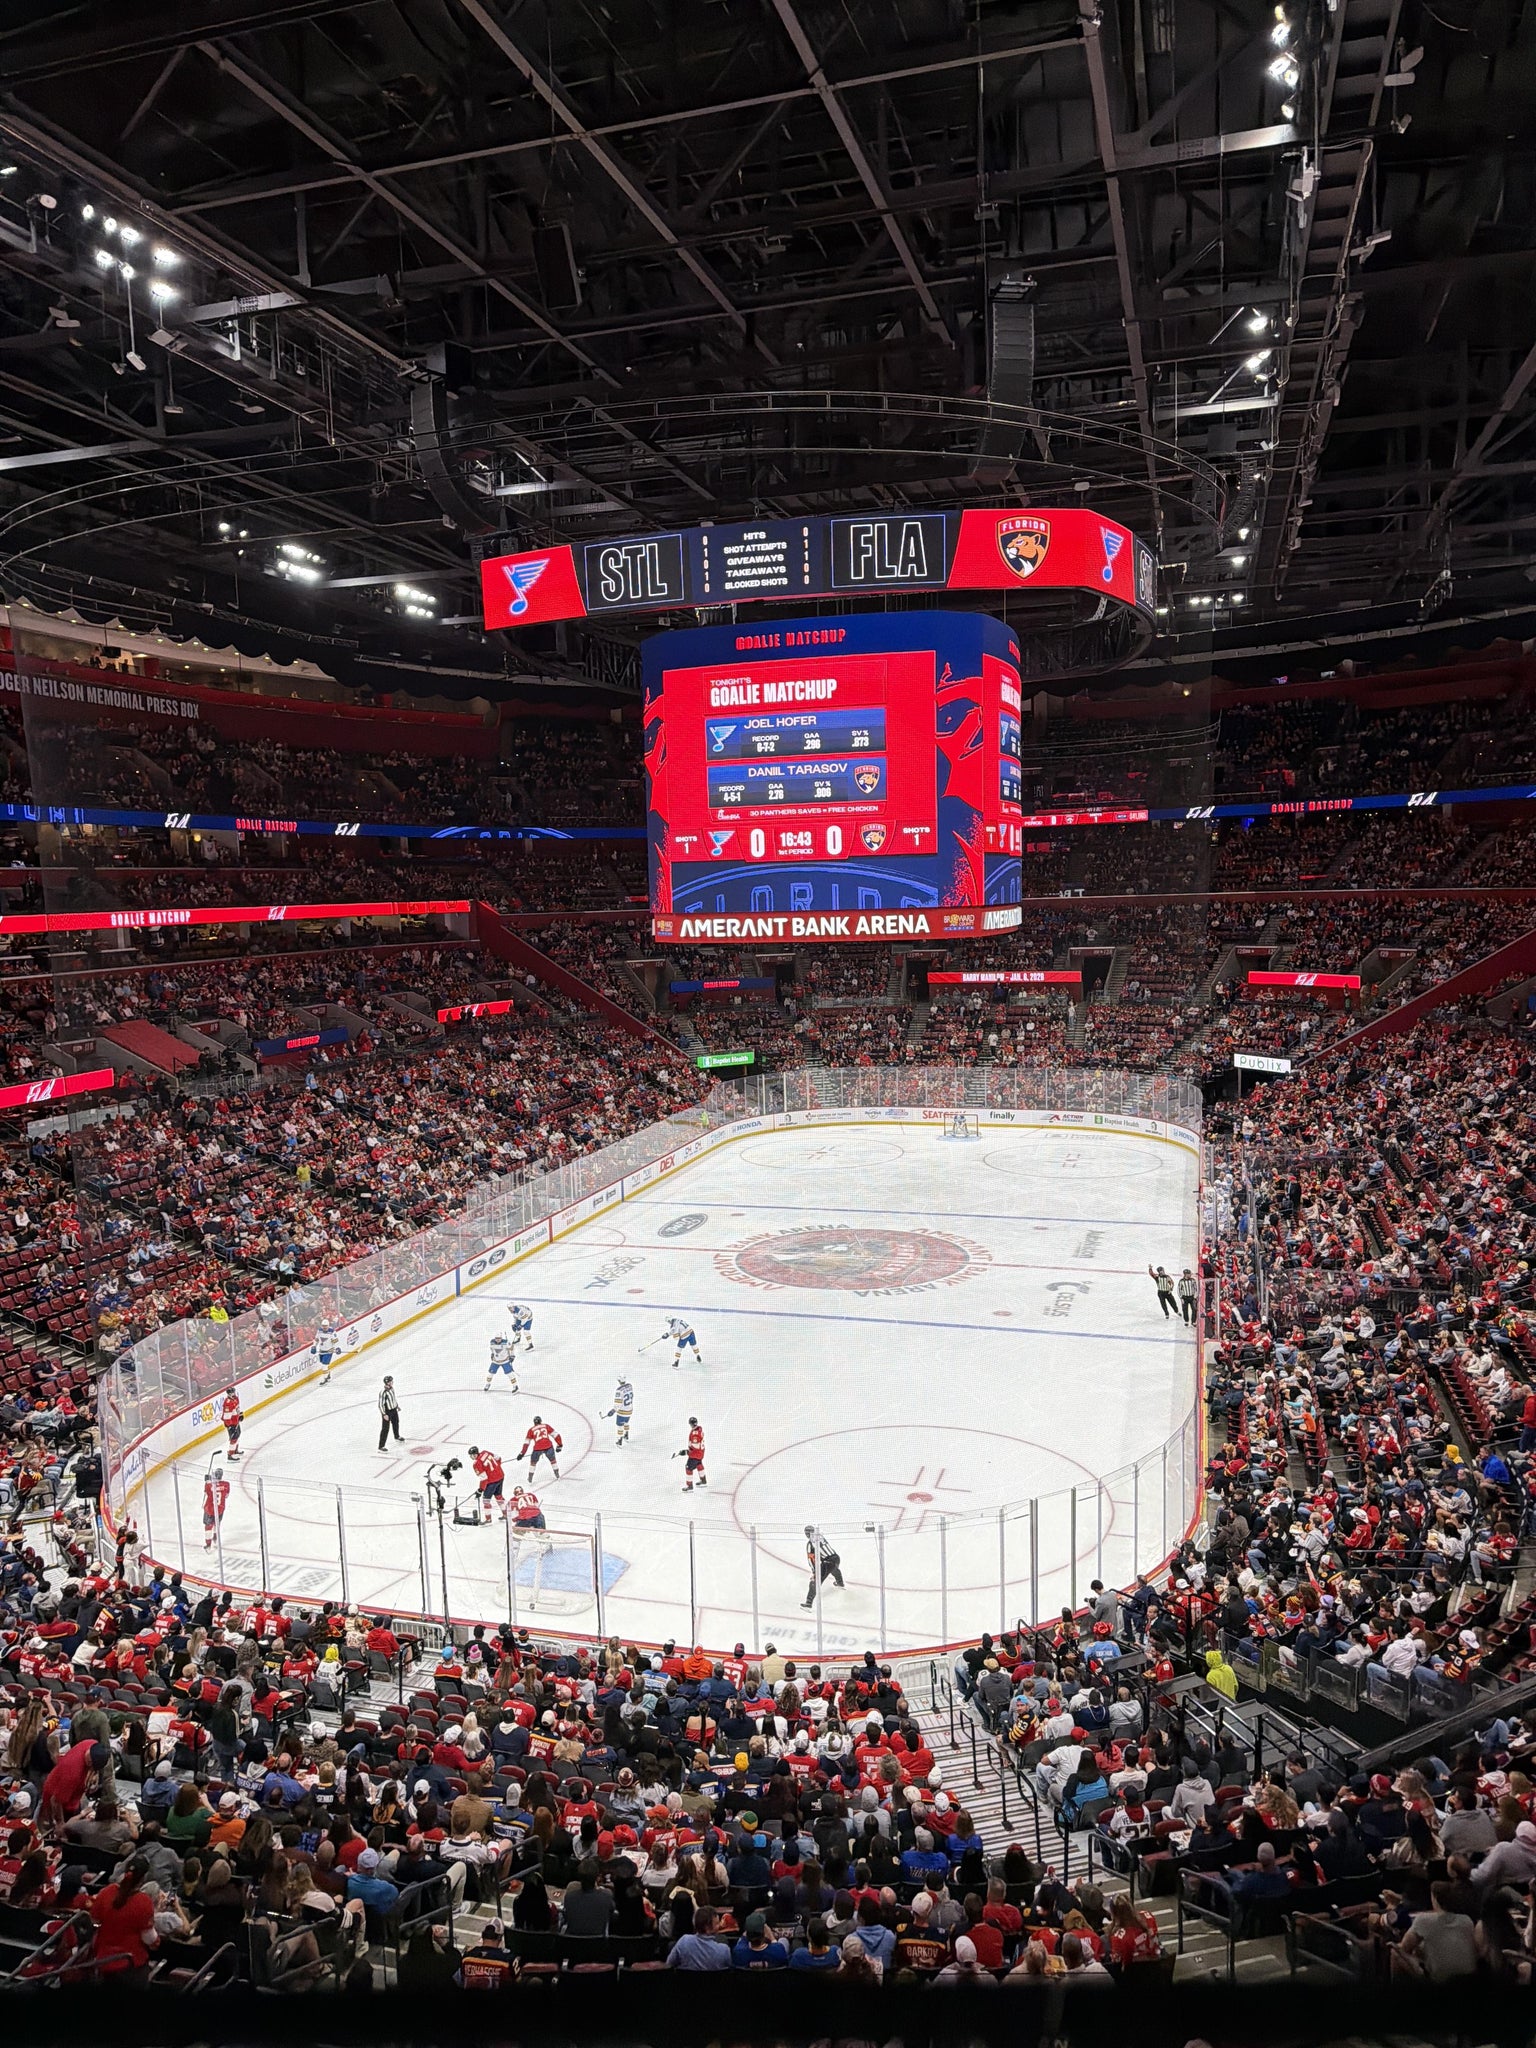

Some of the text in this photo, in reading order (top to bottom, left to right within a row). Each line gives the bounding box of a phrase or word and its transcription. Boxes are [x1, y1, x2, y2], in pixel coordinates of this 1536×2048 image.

[1002, 520, 1045, 532] FLORIDA
[744, 531, 766, 540] HITS
[724, 545, 744, 554] SHOT
[746, 542, 787, 553] ATTEMPTS
[851, 522, 927, 579] FLA
[727, 554, 785, 566] GIVEAWAYS
[600, 543, 667, 602] STL
[726, 565, 786, 578] TAKEAWAYS
[725, 579, 760, 590] BLOCKED
[761, 577, 788, 587] SHOTS
[736, 629, 846, 651] GOALIE MATCHUP
[710, 677, 751, 687] TONIGHT'S
[33, 677, 84, 702] NEILSON
[86, 685, 145, 712] MEMORIAL
[147, 696, 178, 716] PRESS
[180, 702, 200, 719] BOX
[710, 679, 837, 707] GOALIE MATCHUP
[744, 716, 817, 729] JOEL HOFER
[748, 763, 848, 777] DANIIL TARASOV
[1271, 799, 1353, 813] GOALIE MATCHUP
[760, 809, 797, 817] PANTHERS
[235, 817, 263, 830] GOALIE
[750, 828, 766, 858] 0
[780, 831, 812, 847] 16:43
[826, 825, 842, 855] 0
[903, 826, 930, 834] SHOTS
[111, 910, 191, 926] GOALIE MATCHUP
[680, 918, 788, 938] AMERANT
[791, 916, 850, 936] BANK
[855, 914, 930, 935] ARENA
[963, 972, 979, 982] BARRY
[712, 1055, 748, 1065] Baptist Health
[990, 1111, 1015, 1122] finally
[737, 1120, 762, 1132] HONDA
[1179, 1130, 1195, 1142] HONDA
[659, 1154, 675, 1173] DEX
[779, 1223, 851, 1235] ARENA
[533, 1428, 548, 1441] 23
[762, 1626, 796, 1638] TIME
[906, 1946, 939, 1958] BARKOV
